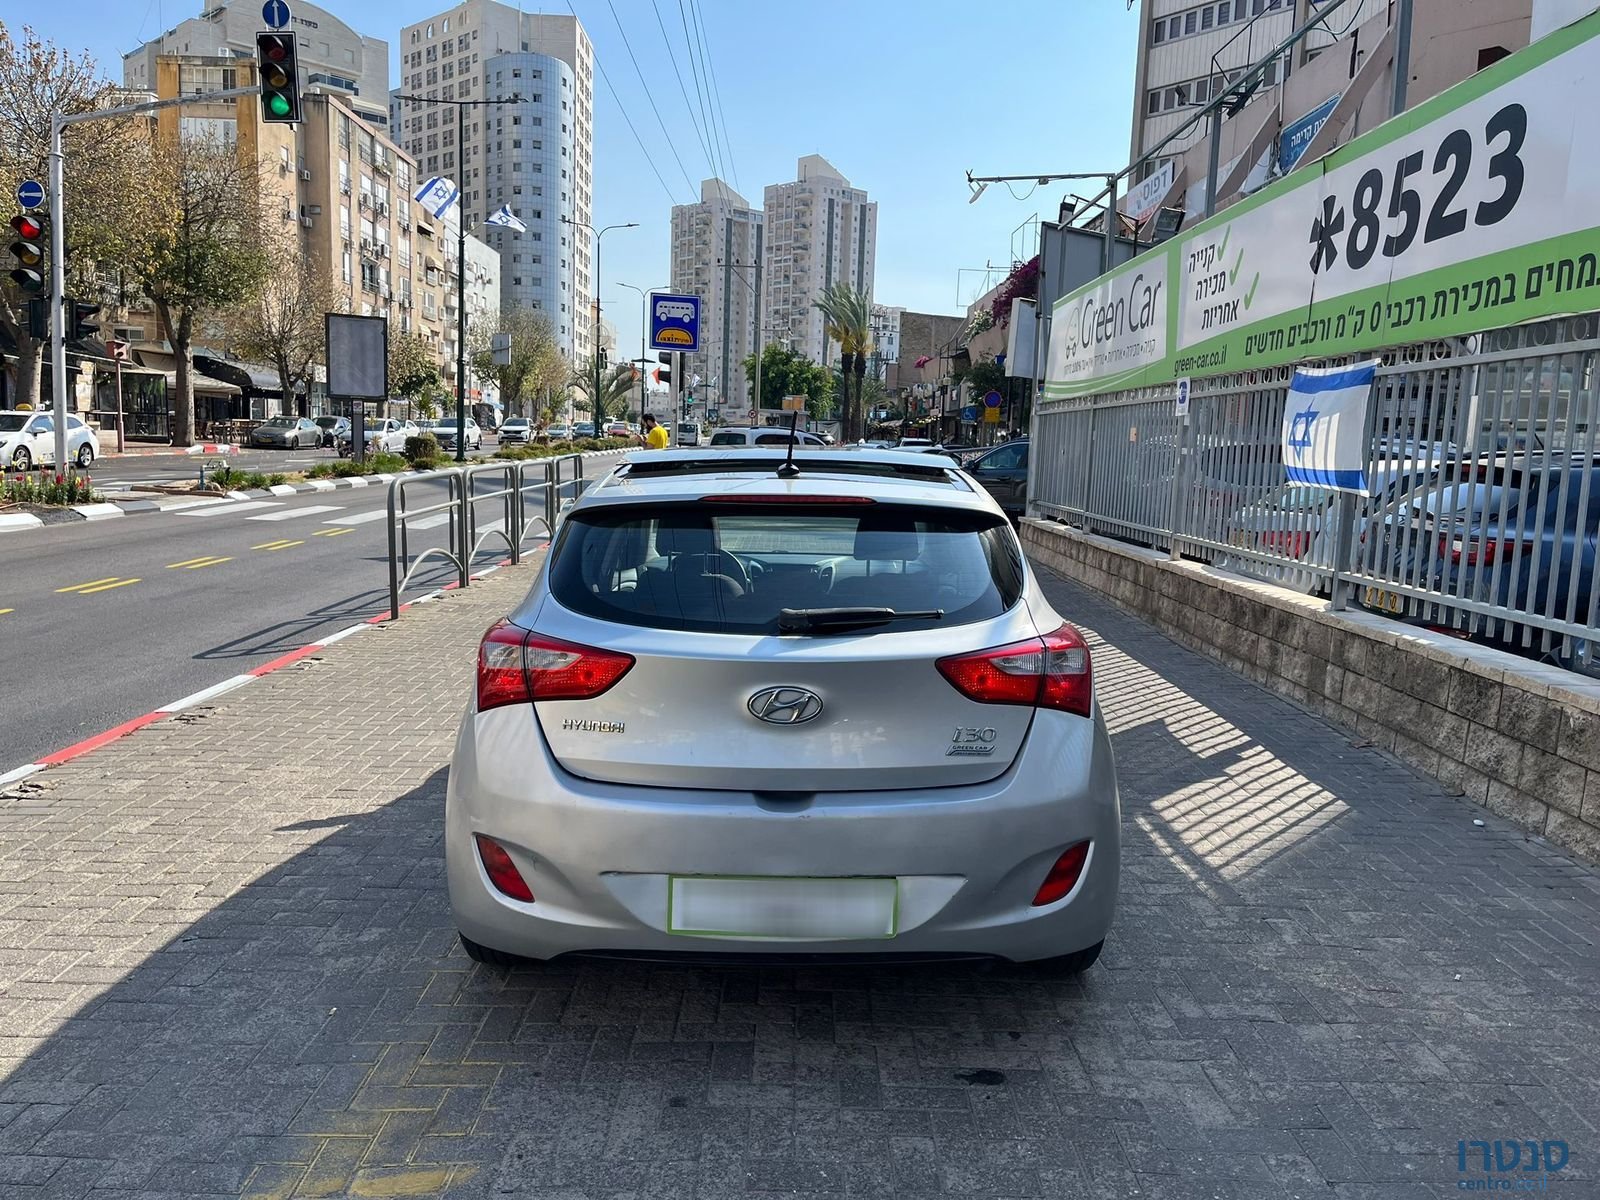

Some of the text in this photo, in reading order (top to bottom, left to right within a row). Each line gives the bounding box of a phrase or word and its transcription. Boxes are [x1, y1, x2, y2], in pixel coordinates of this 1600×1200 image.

[1291, 125, 1312, 148] קדימה
[1143, 170, 1167, 201] דפוס
[1188, 243, 1215, 274] קנייה
[1195, 271, 1226, 301] מכירה
[1525, 253, 1600, 299] מחים
[1081, 273, 1162, 349] Green Car
[1386, 295, 1426, 329] רכבי
[1430, 273, 1517, 321] במכירת
[1201, 298, 1240, 330] אחריות
[1369, 301, 1382, 332] 0
[1245, 329, 1284, 356] חדשים
[1287, 317, 1332, 348] ורכבים
[1174, 344, 1228, 377] green-car.co.il
[563, 719, 625, 733] HYUNDAI
[952, 727, 996, 743] i30
